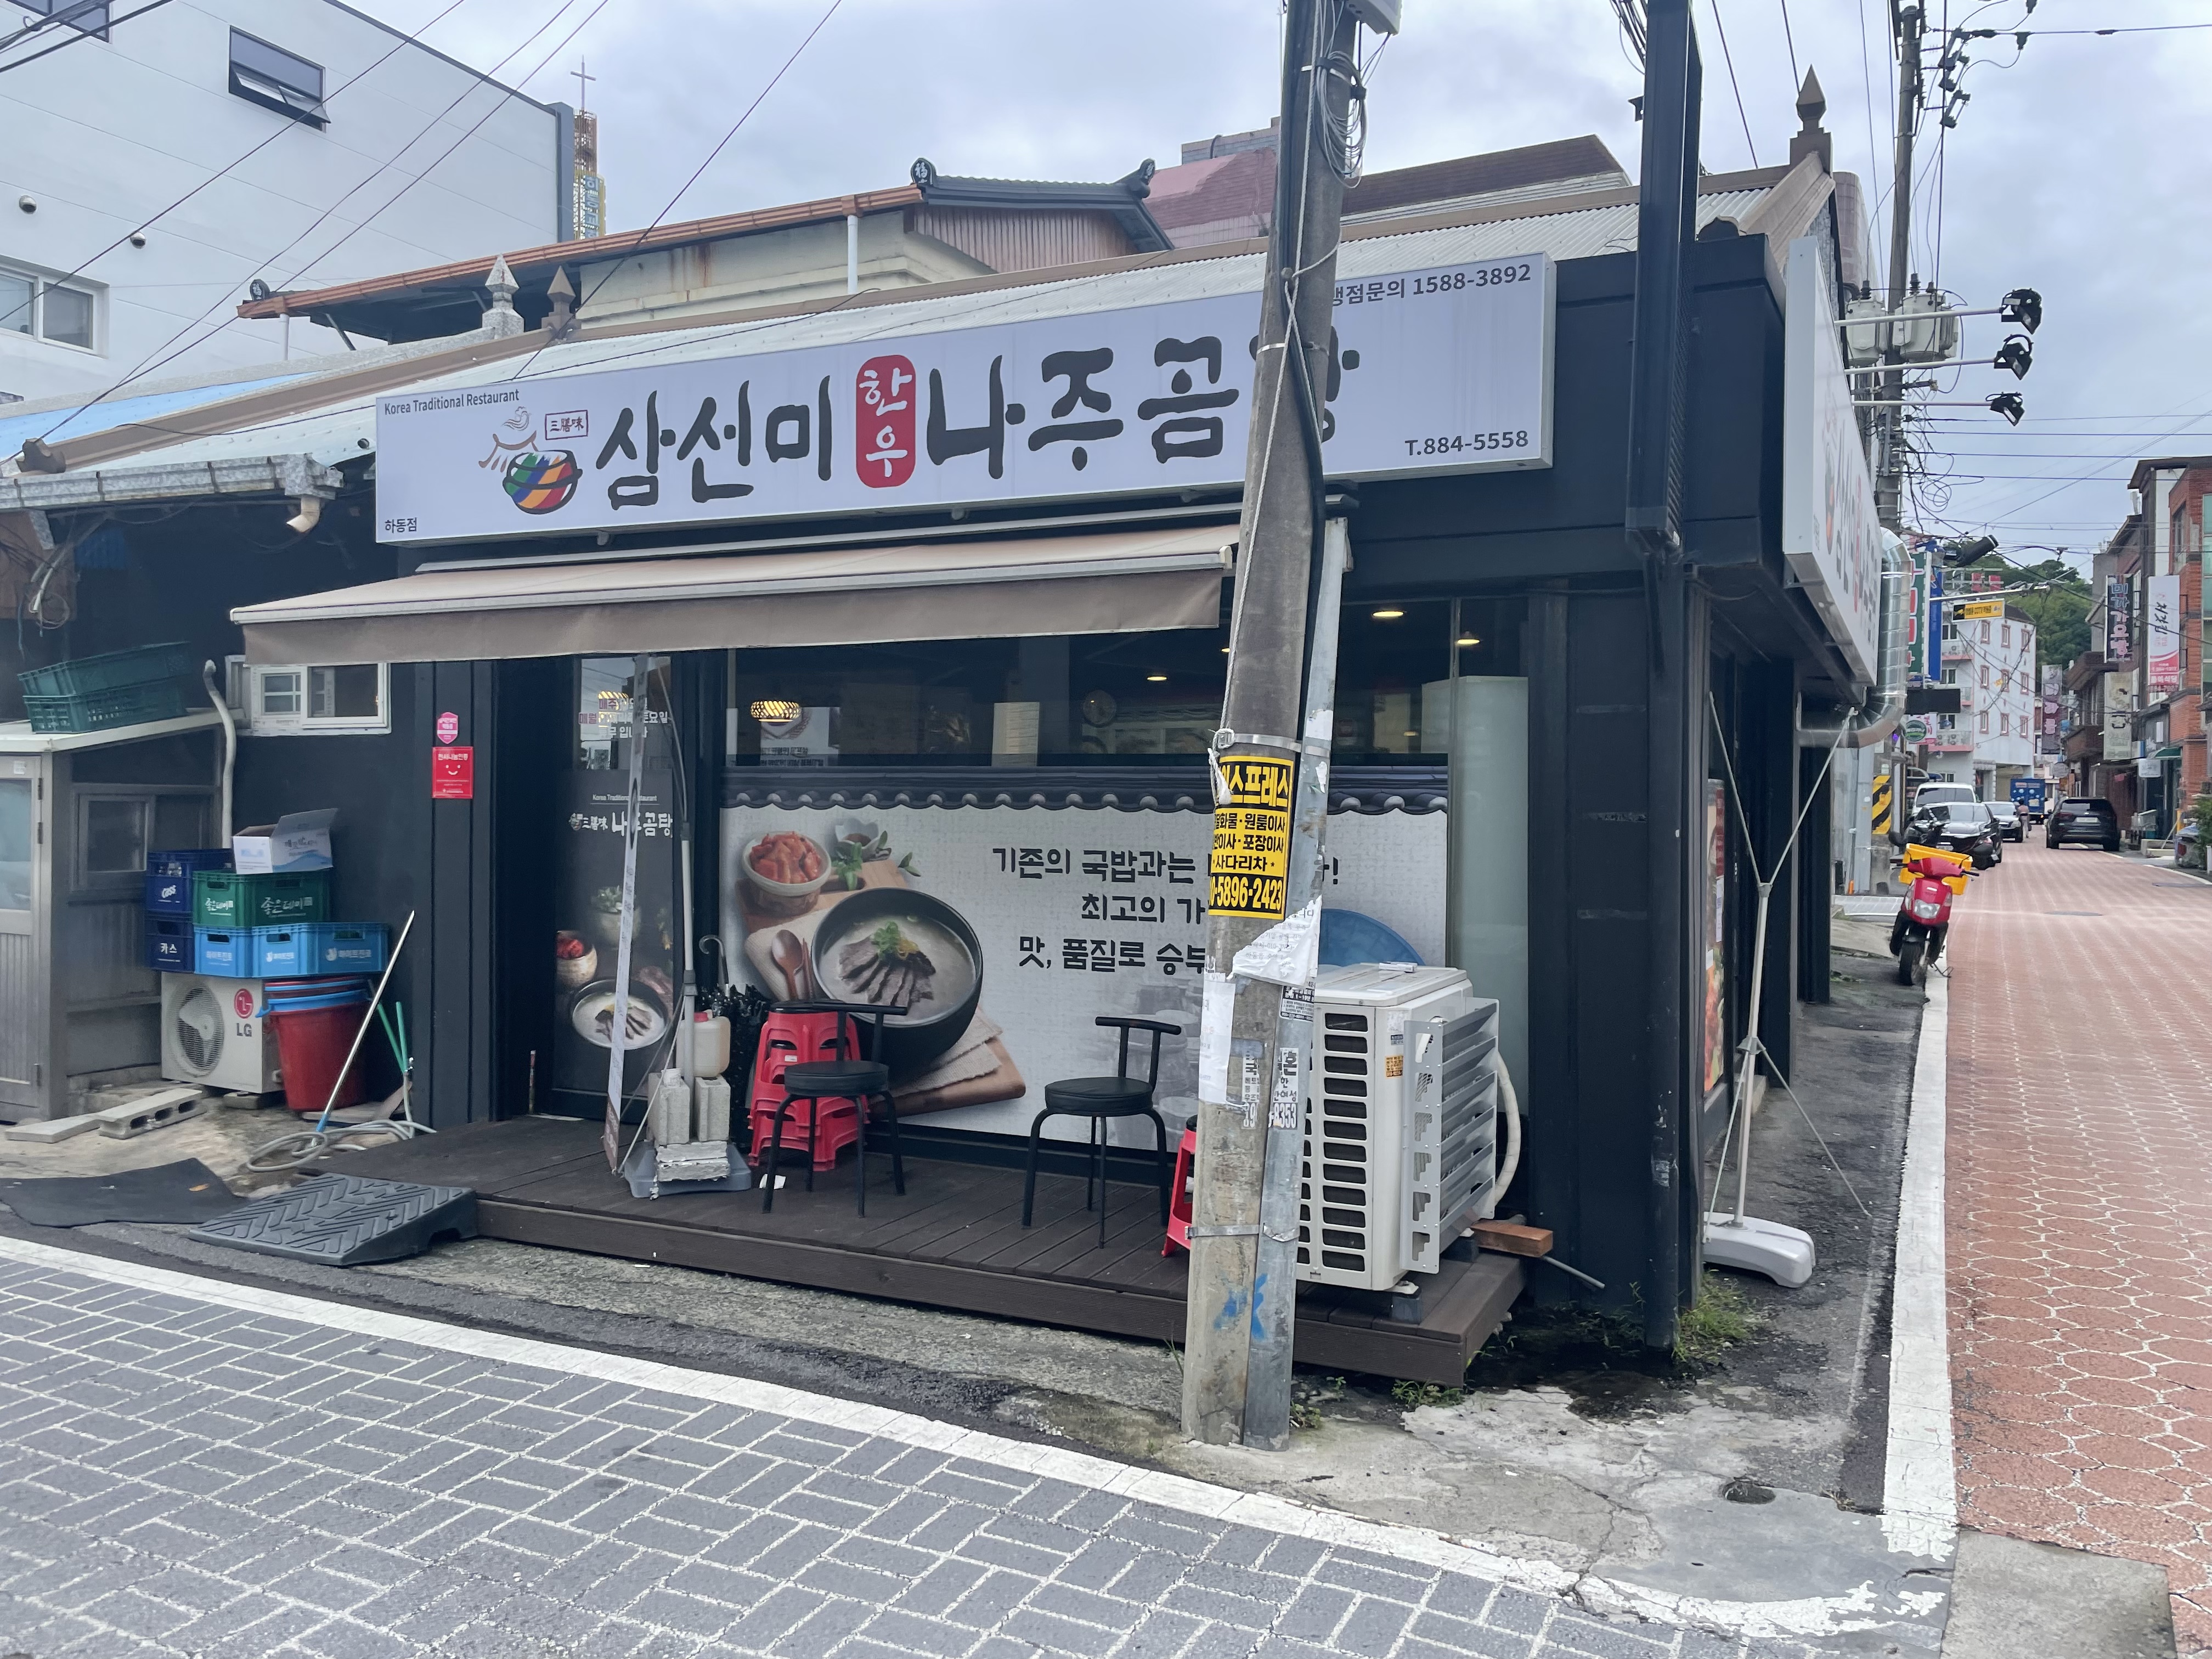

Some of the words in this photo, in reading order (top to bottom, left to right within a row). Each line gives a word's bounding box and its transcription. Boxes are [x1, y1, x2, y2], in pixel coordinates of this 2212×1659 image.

[1413, 264, 1531, 295] 1588-3892
[385, 402, 411, 415] Korea
[413, 394, 464, 412] Traditional
[466, 388, 520, 405] Restaurant
[596, 375, 831, 511] 삼선미
[859, 367, 912, 478] 한우
[1405, 430, 1529, 456] T.884-5558
[385, 516, 418, 534] 하동점
[992, 847, 1070, 879] 기존의
[1082, 849, 1194, 884] 국밥과는
[1215, 854, 1268, 872] 사다리차
[261, 896, 303, 915] 좋은데이
[1081, 893, 1165, 922] 최고의
[160, 943, 178, 954] 카스
[1019, 935, 1052, 969] 맛,
[1062, 938, 1146, 973] 품질로
[236, 1023, 252, 1037] LG
